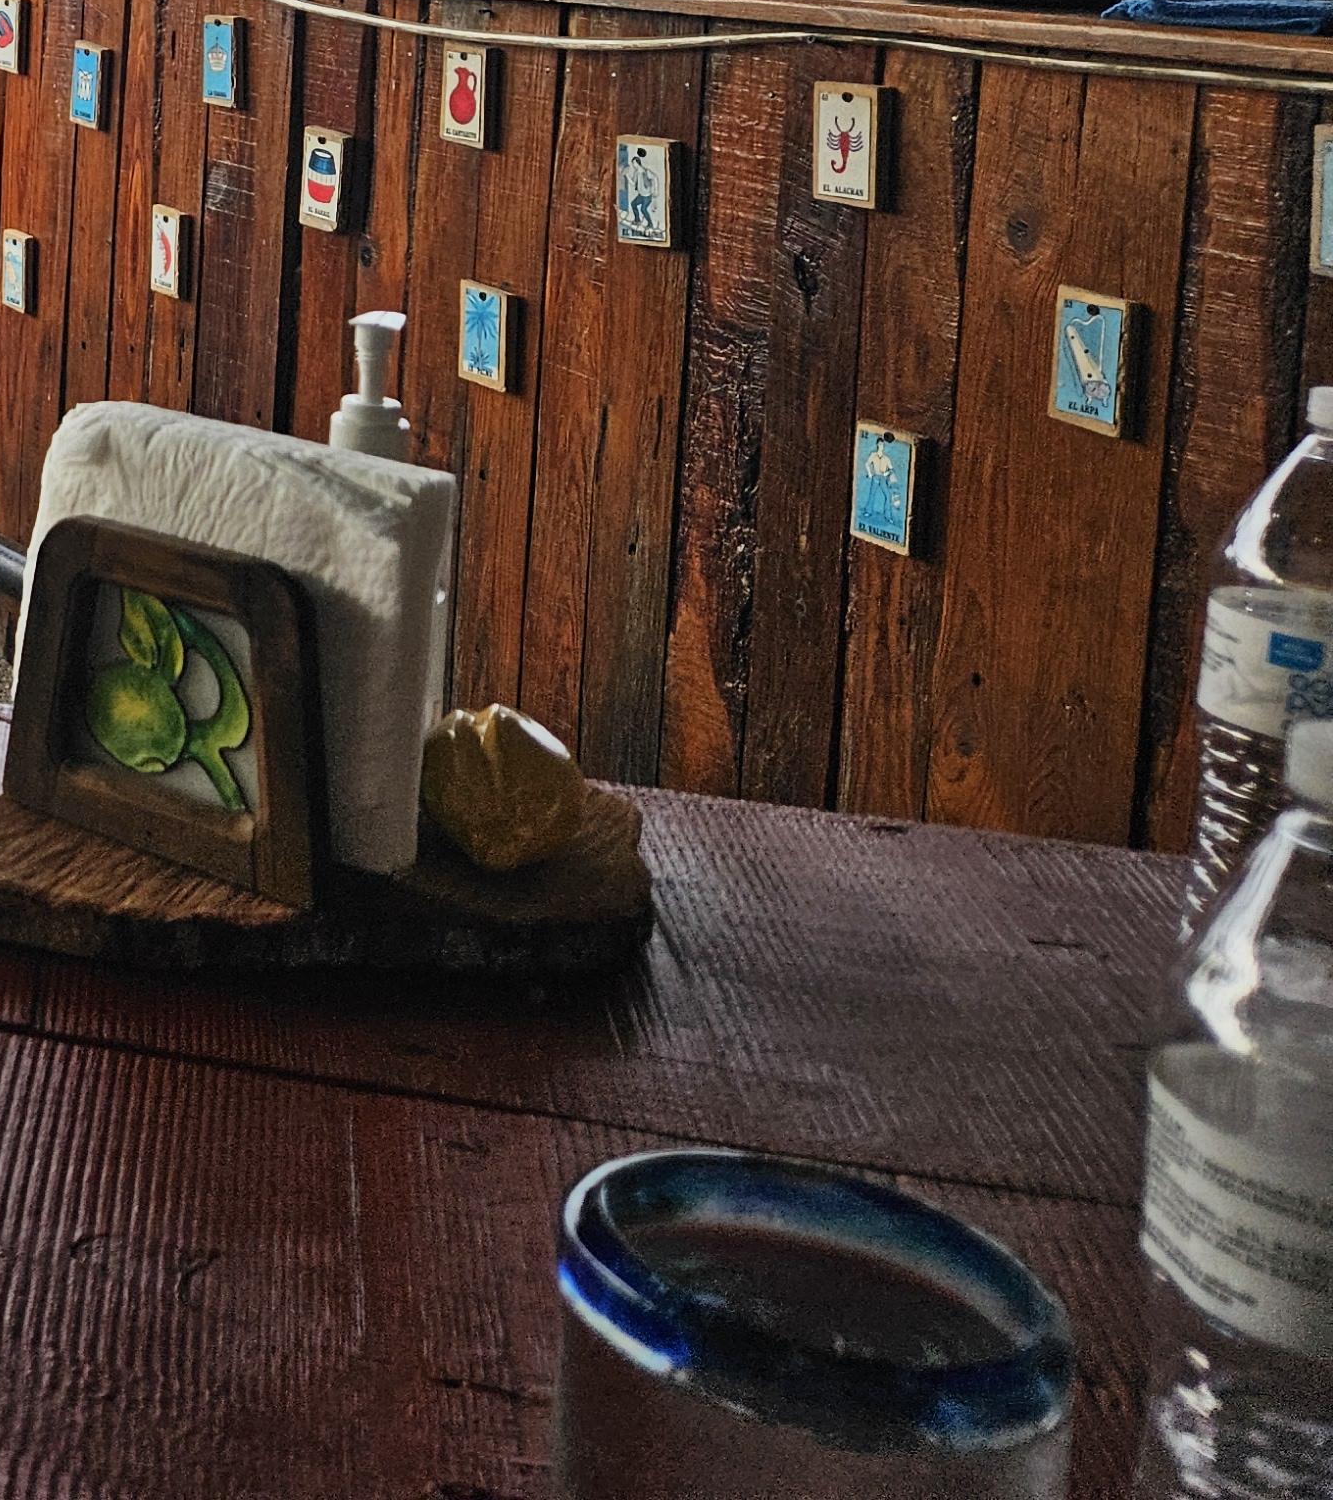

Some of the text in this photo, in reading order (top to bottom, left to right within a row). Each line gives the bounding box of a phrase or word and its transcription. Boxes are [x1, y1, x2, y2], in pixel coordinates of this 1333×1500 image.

[822, 184, 864, 197] EL ALACRAN
[1068, 401, 1099, 416] EL ARPA
[859, 522, 900, 543] EL VALIENTE
